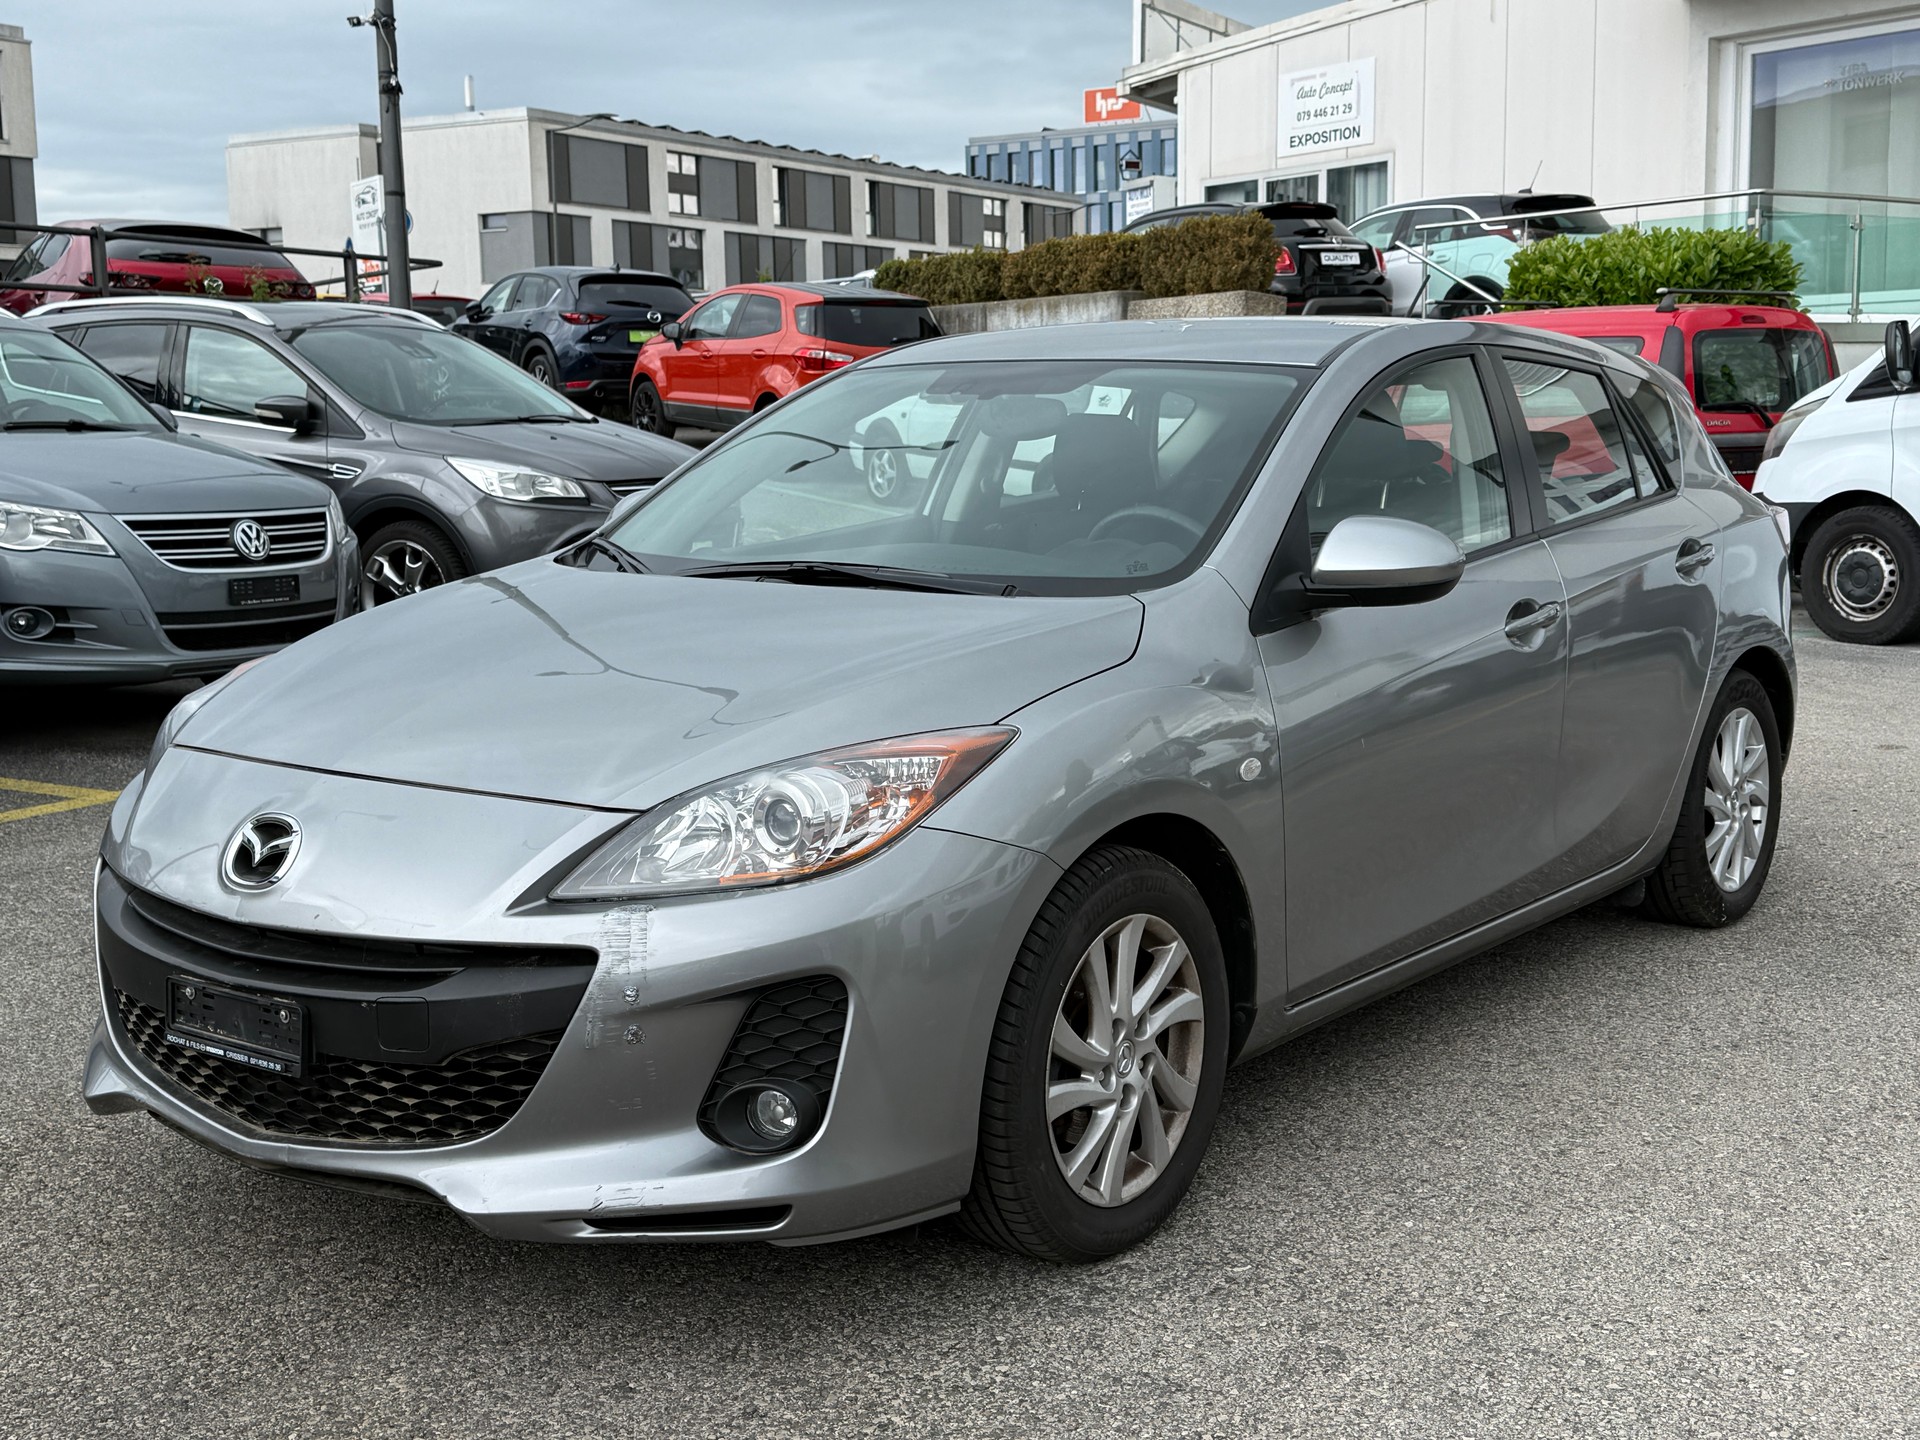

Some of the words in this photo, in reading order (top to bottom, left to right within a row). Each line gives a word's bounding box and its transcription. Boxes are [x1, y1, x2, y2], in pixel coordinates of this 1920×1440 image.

[1296, 86, 1317, 100] Auto
[1319, 78, 1354, 100] Concept
[1838, 70, 1905, 91] TONWERK
[1296, 110, 1311, 122] 079
[1313, 106, 1328, 118] 446
[1330, 104, 1340, 116] 21
[1342, 103, 1353, 114] 29
[1289, 125, 1361, 148] EXPOSITION
[1323, 254, 1354, 262] QUALITY
